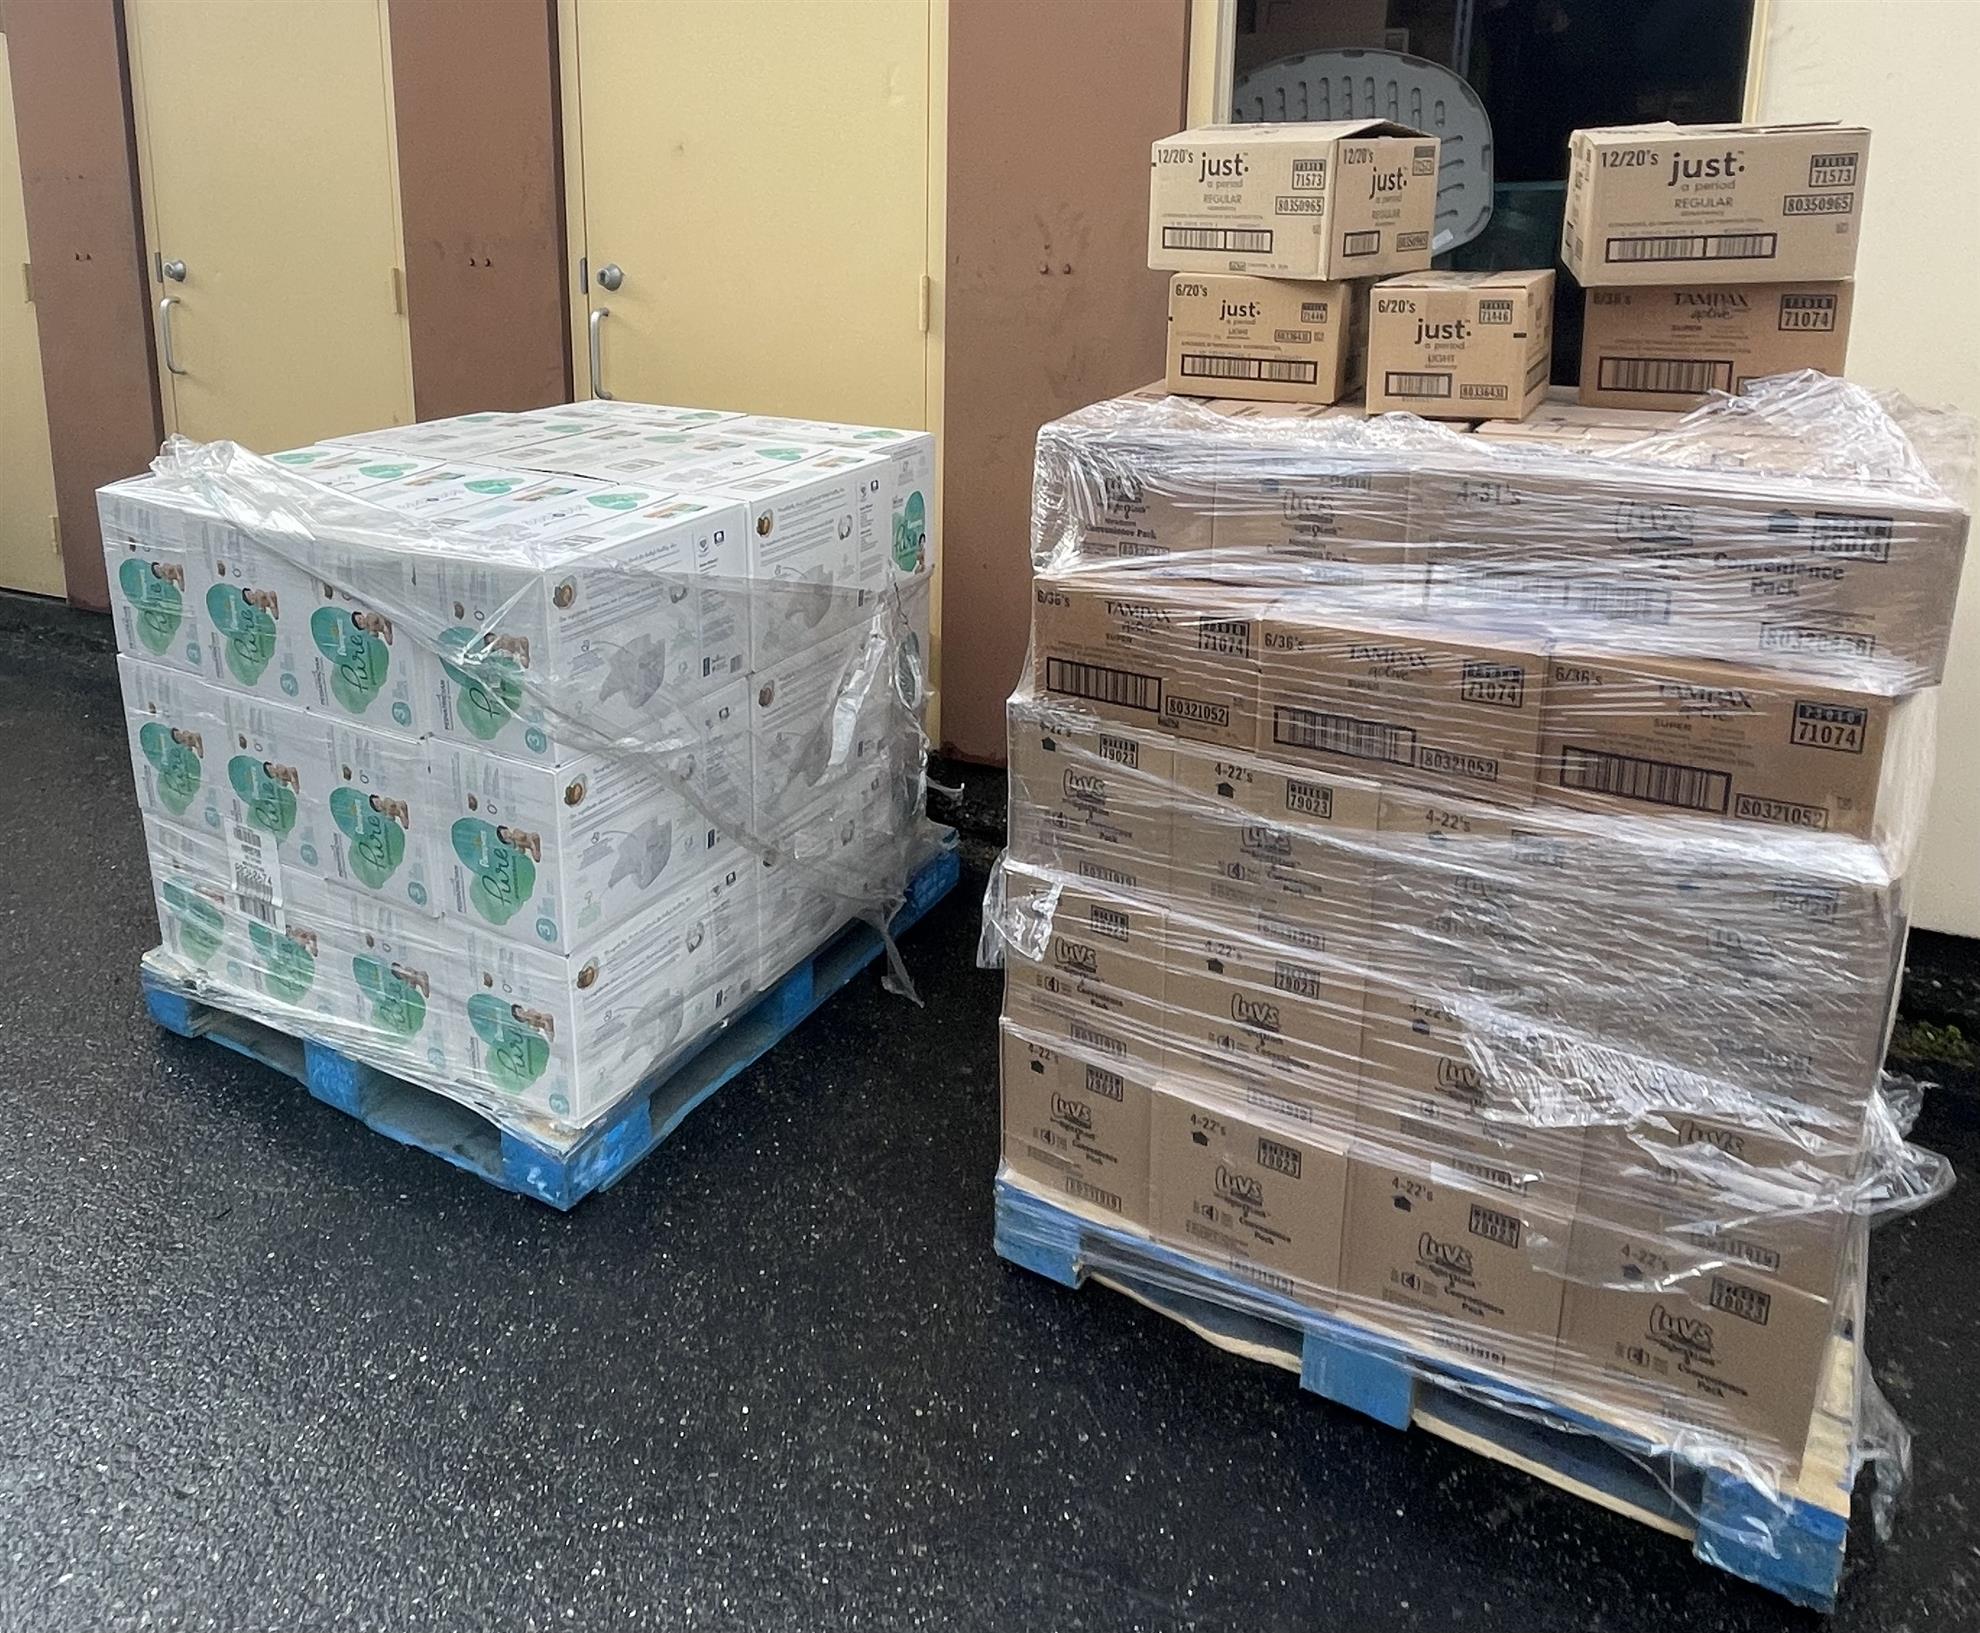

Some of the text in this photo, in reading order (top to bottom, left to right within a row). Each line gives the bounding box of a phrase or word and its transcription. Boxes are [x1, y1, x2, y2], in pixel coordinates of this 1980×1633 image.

[1158, 149, 1193, 164] 12/20's
[1602, 150, 1659, 168] 12/20's
[1296, 174, 1322, 186] 71573
[1815, 169, 1851, 183] 71573
[1681, 180, 1736, 192] a period
[1278, 200, 1322, 212] 80350965
[1674, 197, 1734, 209] REGULAR
[1787, 198, 1849, 213] 80350965
[1175, 284, 1208, 297] 6/20's
[1378, 300, 1416, 313] 6/20's
[1784, 312, 1829, 327] 71074
[1265, 633, 1304, 650] 6/36's
[341, 634, 368, 693] Pure
[1468, 683, 1516, 702] 71074
[1170, 699, 1225, 722] 80321052
[529, 734, 540, 746] 3
[1800, 722, 1857, 746] 71074
[1102, 749, 1135, 765] 79023
[1215, 763, 1253, 783] 4-22's
[1290, 795, 1328, 815] 79023
[1741, 800, 1822, 826] 80321052
[1426, 810, 1471, 832] 4-22's
[358, 815, 386, 871] Pure
[481, 847, 513, 906] Pure
[1279, 976, 1315, 996] 79023
[1191, 1114, 1226, 1135] 4-22's
[1392, 1176, 1433, 1201] 4-22's
